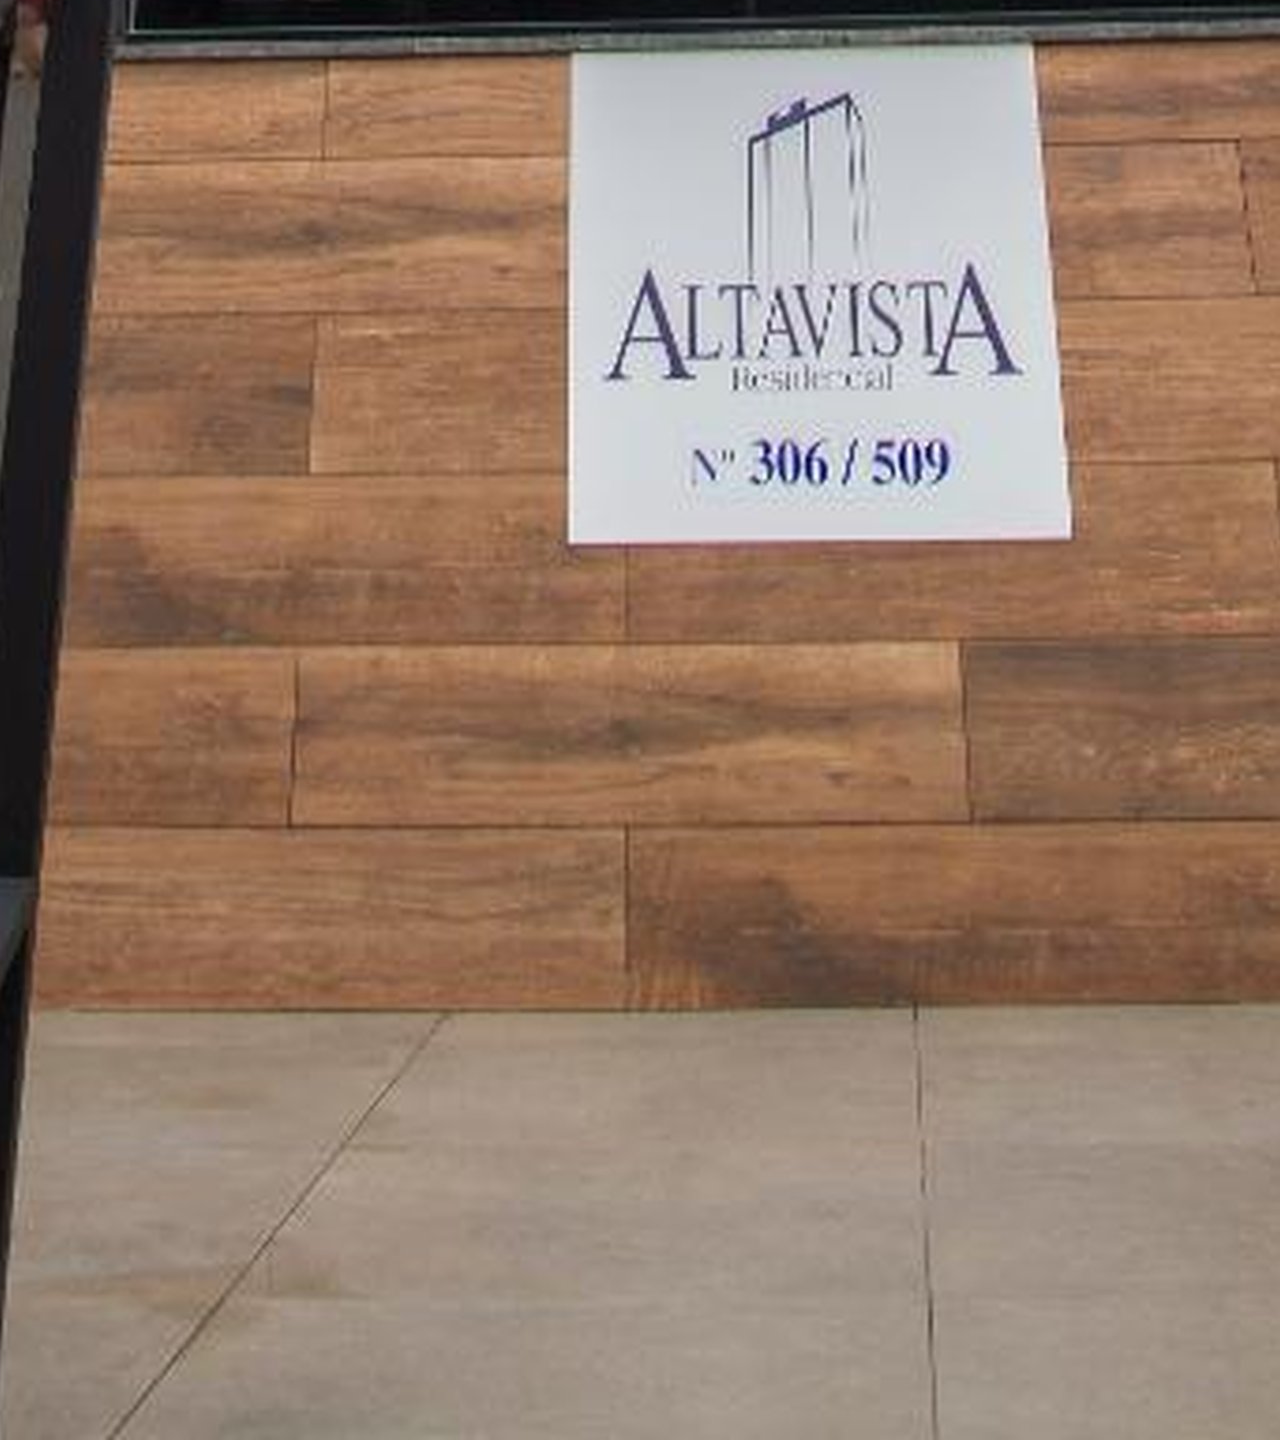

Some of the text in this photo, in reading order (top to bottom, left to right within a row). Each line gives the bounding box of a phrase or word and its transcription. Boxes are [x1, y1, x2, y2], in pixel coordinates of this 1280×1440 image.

[603, 262, 1023, 382] ALTAVISTA
[750, 437, 829, 486] 306
[841, 437, 859, 486] /
[872, 437, 950, 486] 509
